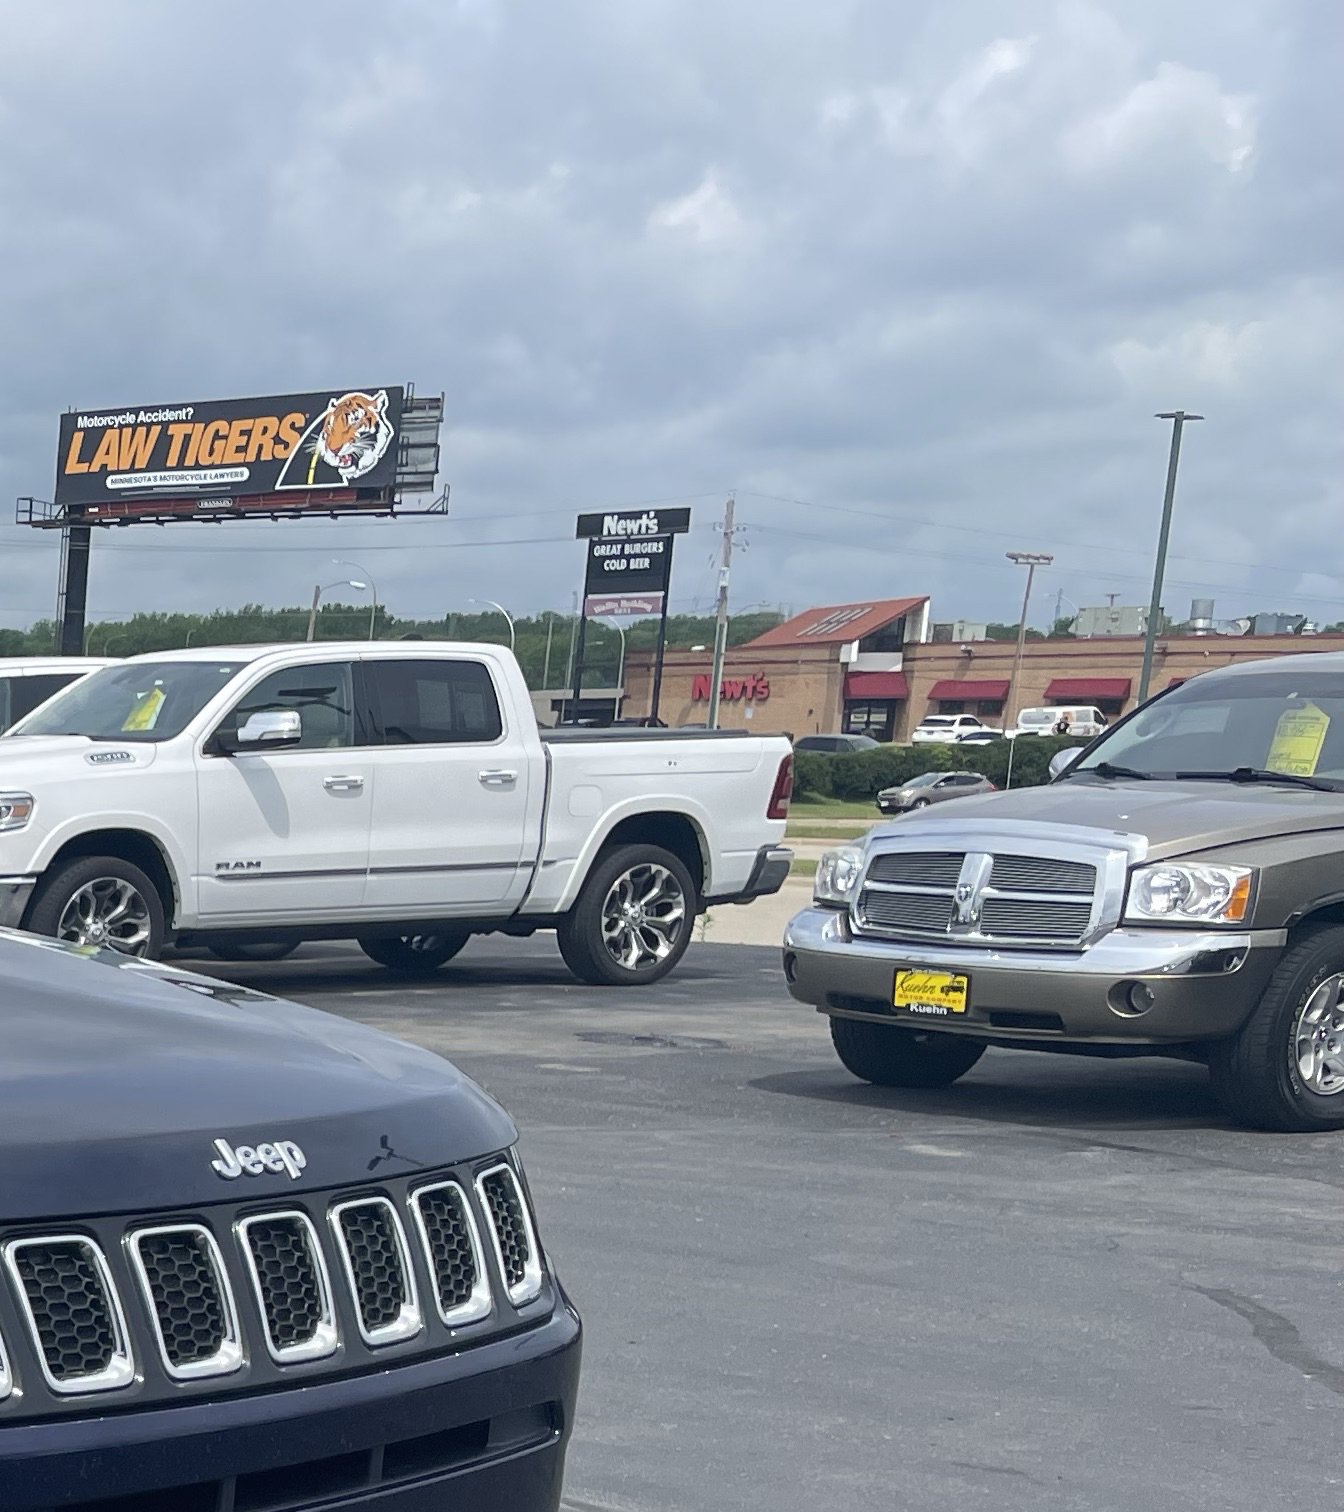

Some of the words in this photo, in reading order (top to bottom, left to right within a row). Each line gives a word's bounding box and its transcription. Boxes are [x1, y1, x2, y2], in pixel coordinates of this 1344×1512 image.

[77, 411, 136, 429] Motorcycle
[137, 407, 194, 423] Accident?
[65, 425, 162, 475] LAW
[166, 411, 306, 468] TIGERS
[159, 472, 208, 483] MOTORCYCLE
[209, 470, 245, 480] LAWYERS
[602, 511, 659, 536] Newt's
[593, 544, 621, 557] GREAT
[624, 542, 664, 555] BURGERS
[603, 559, 626, 571] COLD
[629, 557, 650, 570] BEER
[215, 861, 261, 871] RAM
[896, 973, 936, 994] Kuehn
[909, 1002, 948, 1015] Kuehn
[211, 1138, 307, 1180] Jeep
